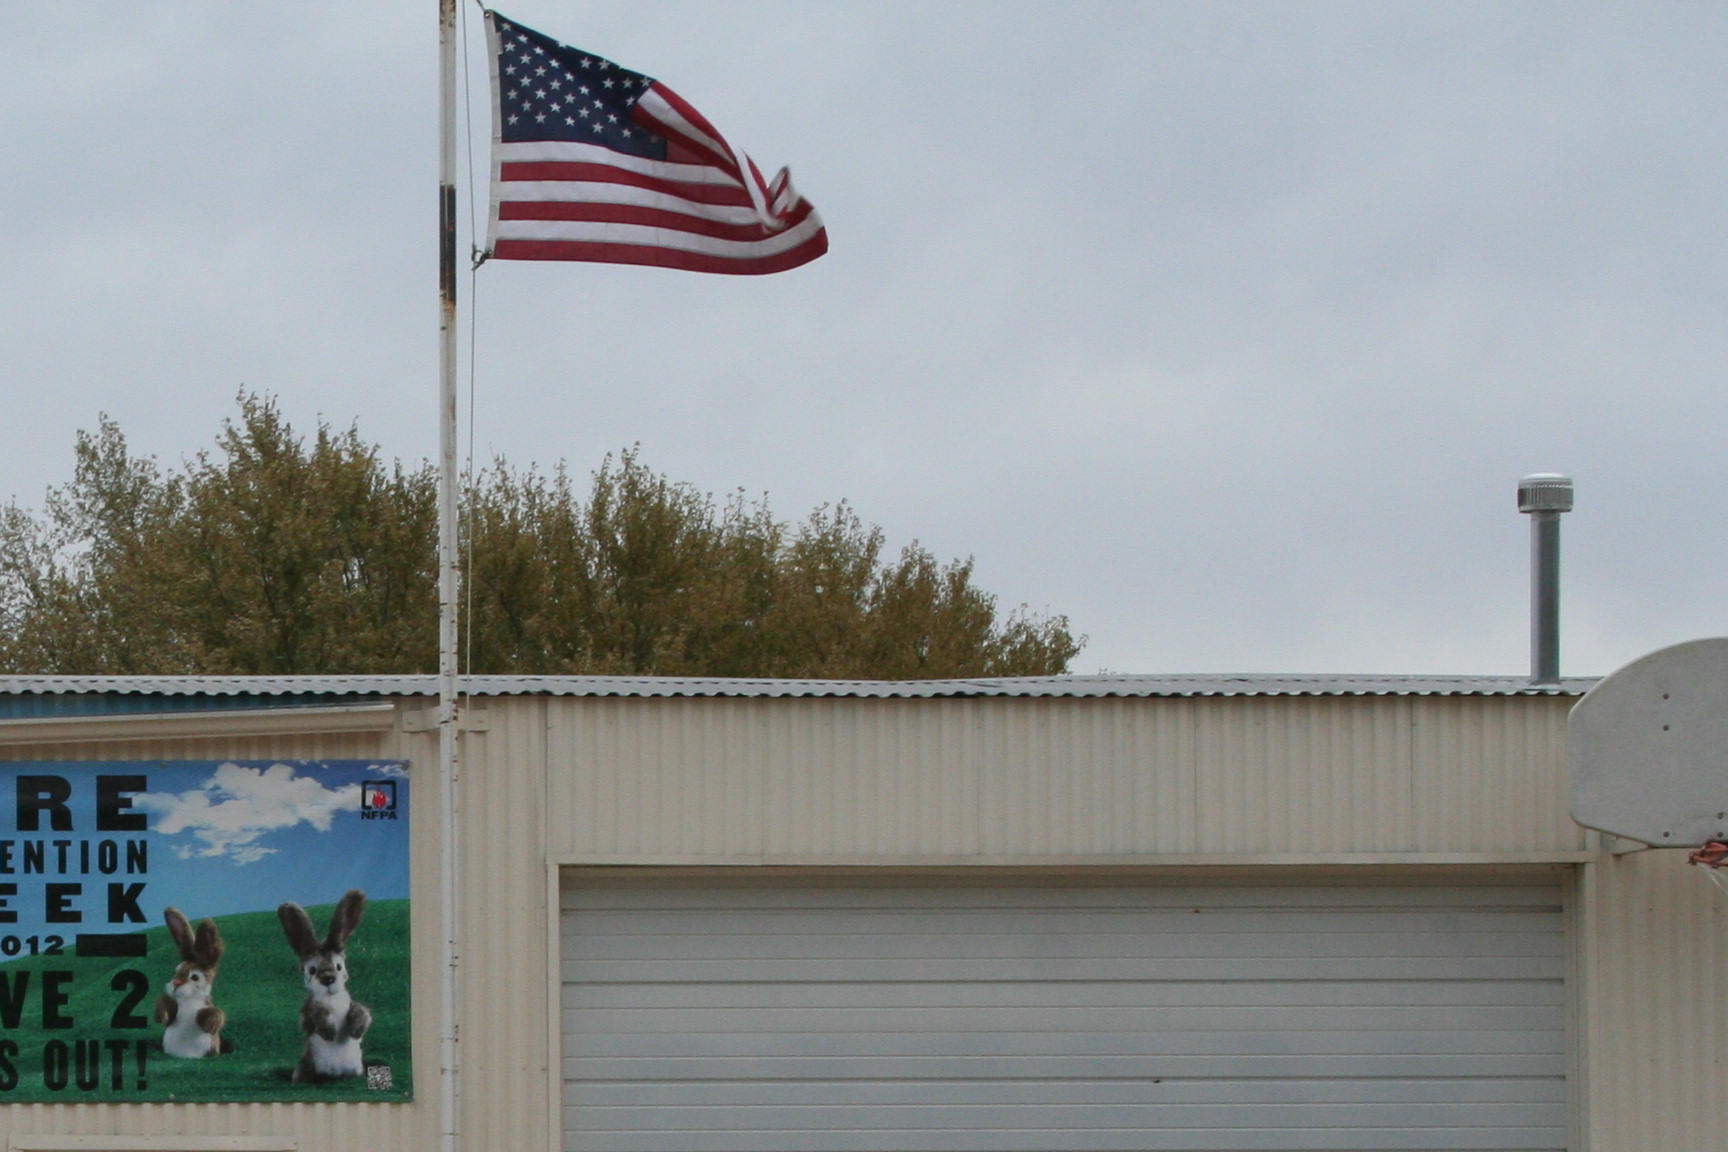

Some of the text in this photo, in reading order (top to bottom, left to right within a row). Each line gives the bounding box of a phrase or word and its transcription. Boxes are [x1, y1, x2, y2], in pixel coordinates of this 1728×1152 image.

[361, 811, 398, 820] NFPA
[110, 969, 149, 1029] 2
[43, 1040, 147, 1092] OUT!
